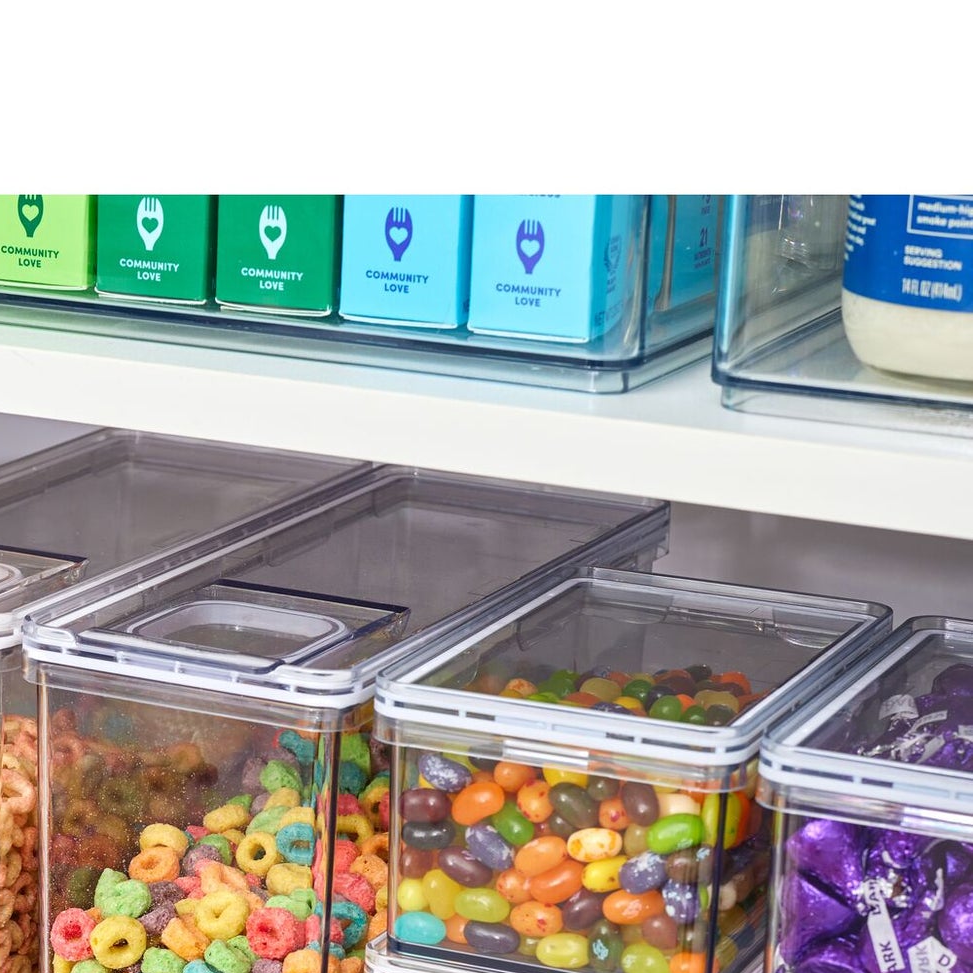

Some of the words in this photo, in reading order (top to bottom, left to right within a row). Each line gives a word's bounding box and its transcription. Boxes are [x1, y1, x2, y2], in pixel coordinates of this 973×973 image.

[1, 246, 59, 258] COMMUNITY
[905, 245, 943, 259] SERVING
[19, 258, 41, 268] LOVE
[120, 258, 179, 272] COMMUNITY
[904, 255, 962, 271] SUGGESTION
[138, 271, 161, 281] LOVE
[241, 267, 304, 281] COMMUNITY
[366, 270, 429, 283] COMMUNITY
[260, 280, 284, 291] LOVE
[385, 283, 410, 293] LOVE
[496, 284, 561, 297] COMMUNITY
[515, 297, 540, 306] LOVE
